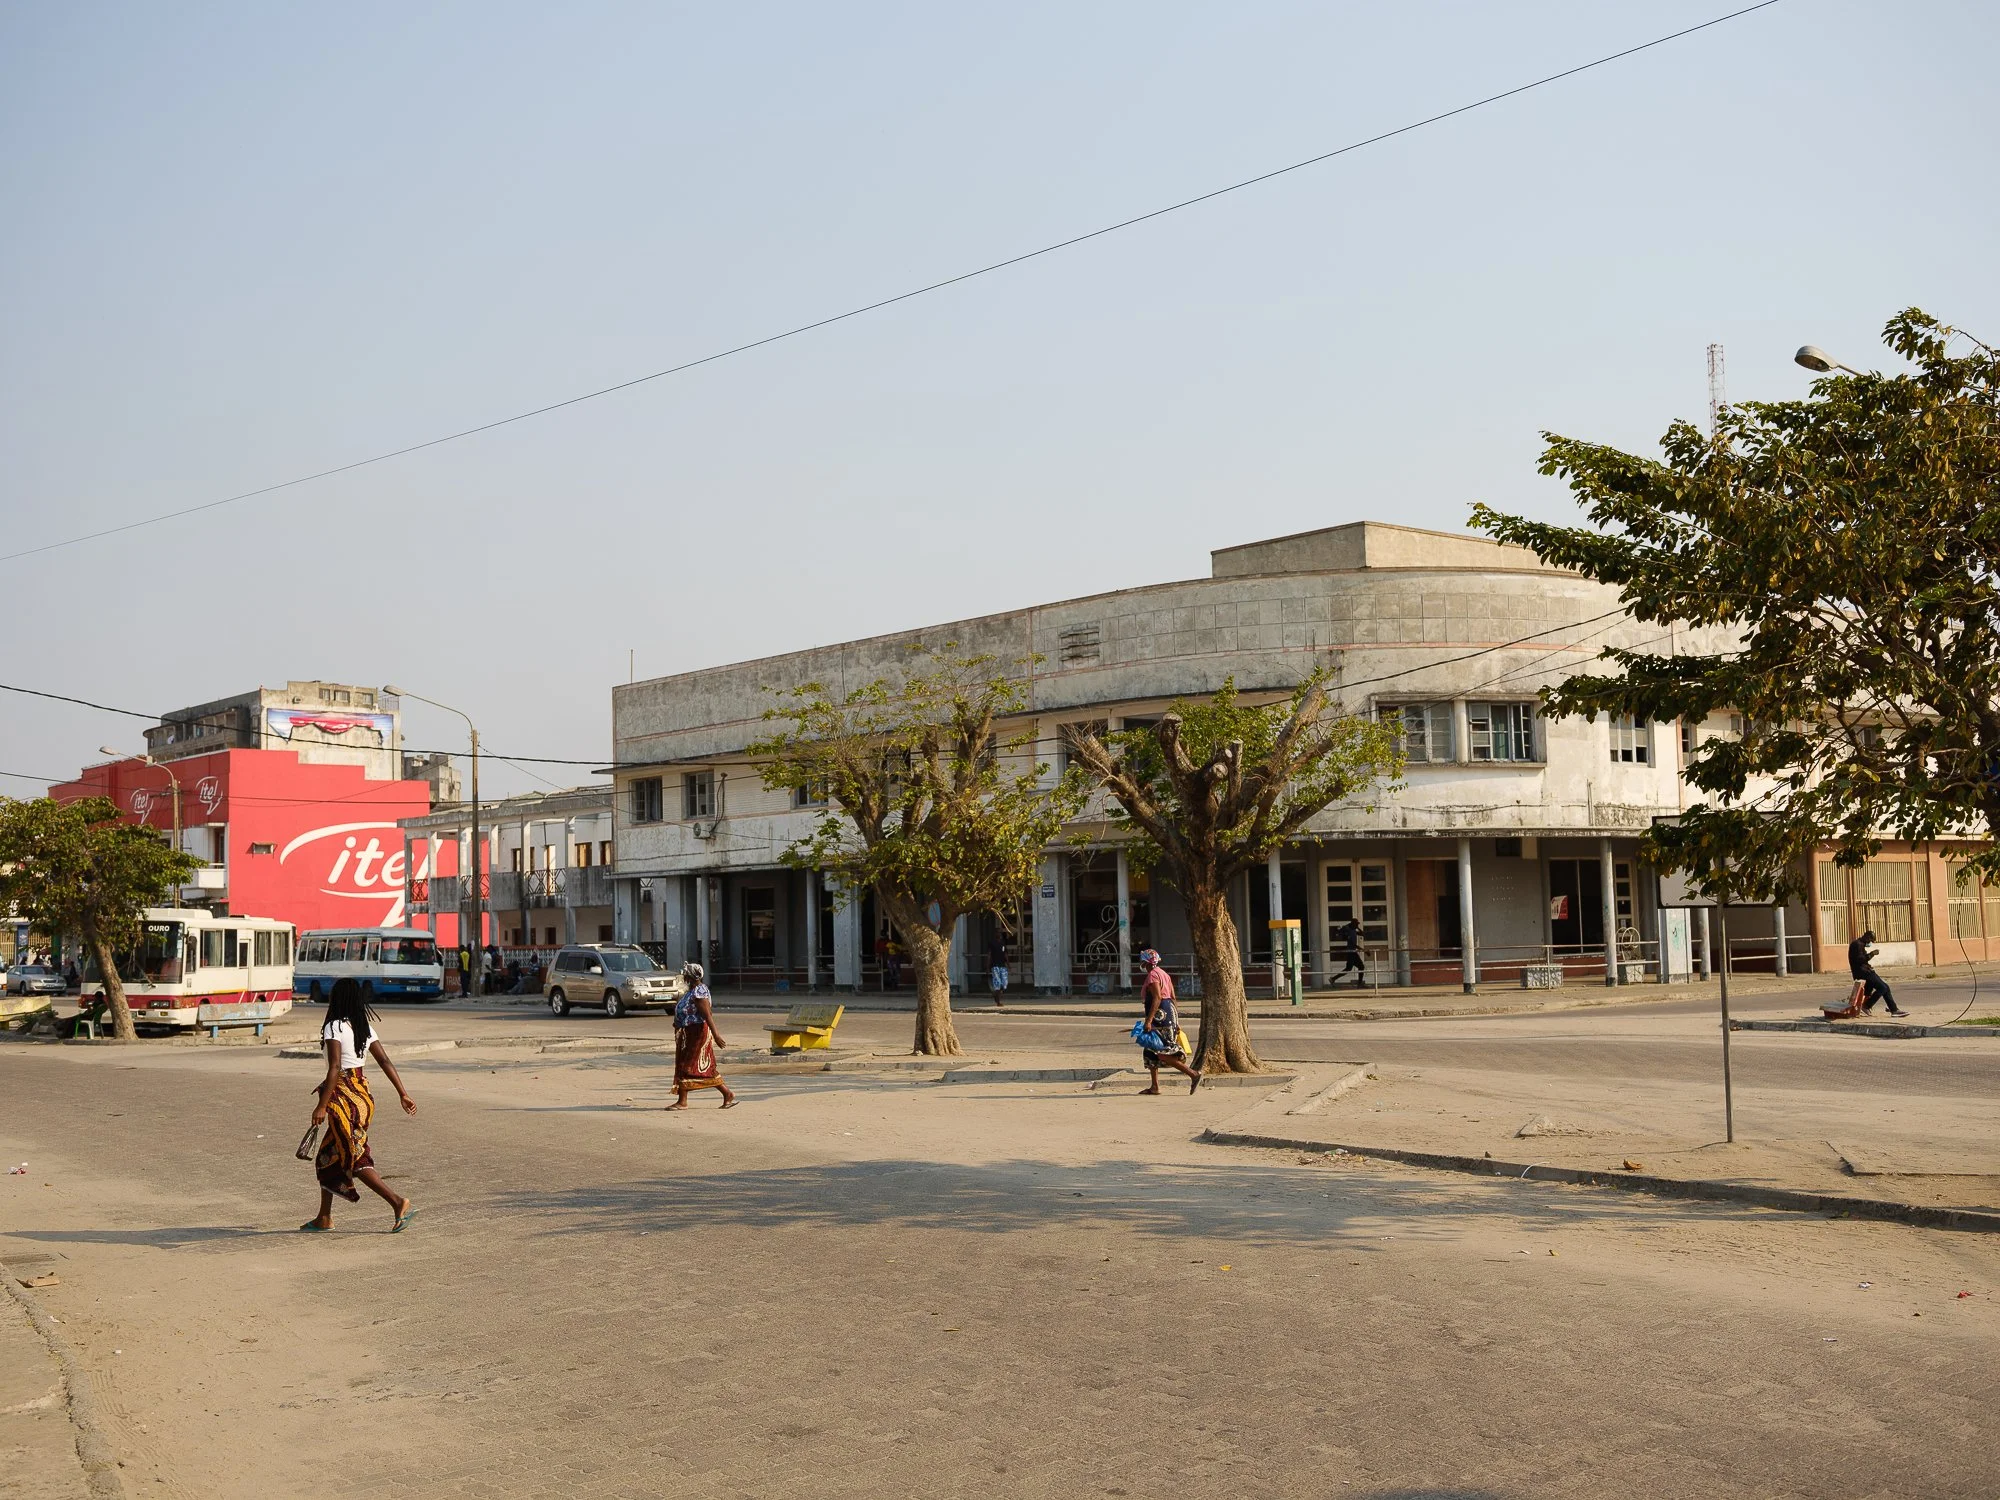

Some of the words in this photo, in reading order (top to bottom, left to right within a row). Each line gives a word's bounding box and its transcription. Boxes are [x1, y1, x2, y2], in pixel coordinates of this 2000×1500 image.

[199, 780, 219, 800] itel
[134, 793, 149, 810] itel
[327, 836, 443, 888] itel
